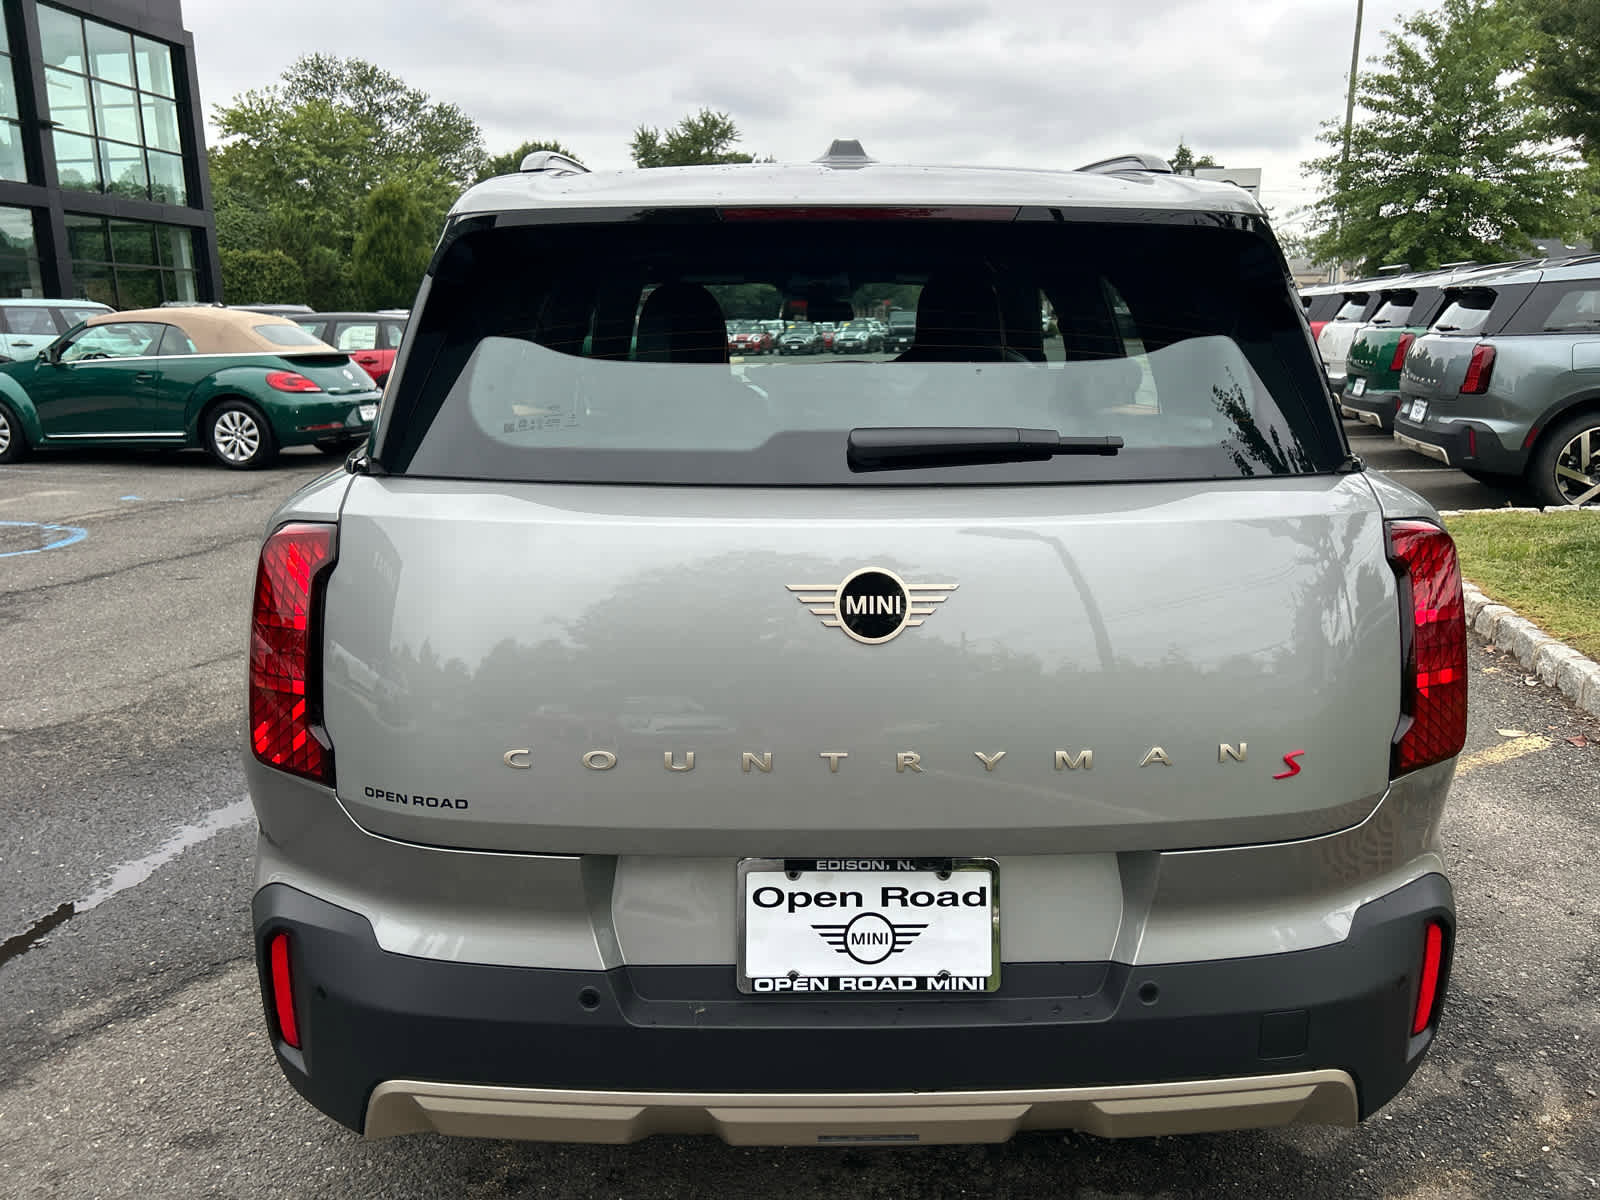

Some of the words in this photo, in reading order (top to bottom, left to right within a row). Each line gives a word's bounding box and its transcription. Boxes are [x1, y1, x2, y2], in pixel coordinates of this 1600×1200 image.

[846, 595, 901, 615] MINI
[503, 742, 1249, 773] COUNTRYMAN
[1272, 749, 1305, 780] S
[364, 786, 408, 805] OPEN
[412, 795, 469, 809] ROAD
[816, 860, 890, 871] EDISON,
[752, 886, 863, 913] Open
[881, 886, 987, 908] Road
[851, 932, 889, 945] MINI
[754, 977, 829, 991] OPEN
[839, 977, 917, 991] ROAD
[927, 976, 985, 991] MINI
